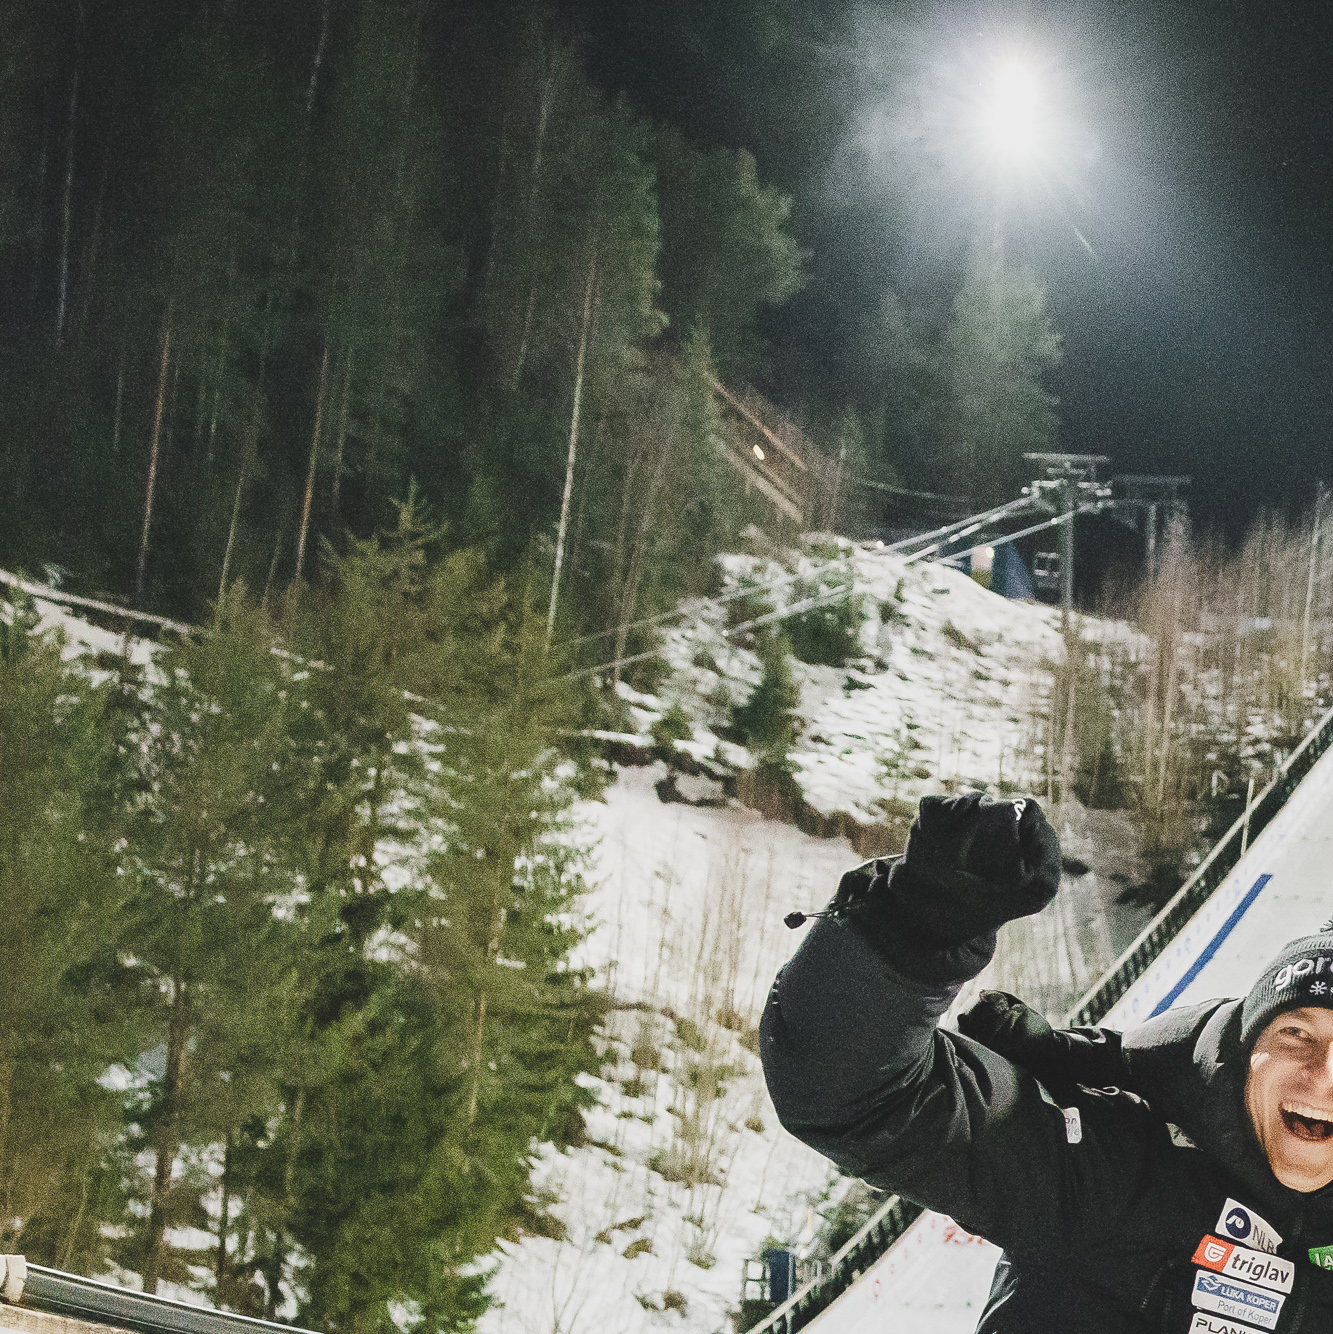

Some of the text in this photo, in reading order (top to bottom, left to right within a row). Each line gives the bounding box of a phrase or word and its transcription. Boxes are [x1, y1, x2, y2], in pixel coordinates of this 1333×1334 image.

[1231, 1254, 1289, 1284] triglav
[1220, 1287, 1277, 1312] LUKA KOPER
[1217, 1300, 1272, 1325] Port of Koper
